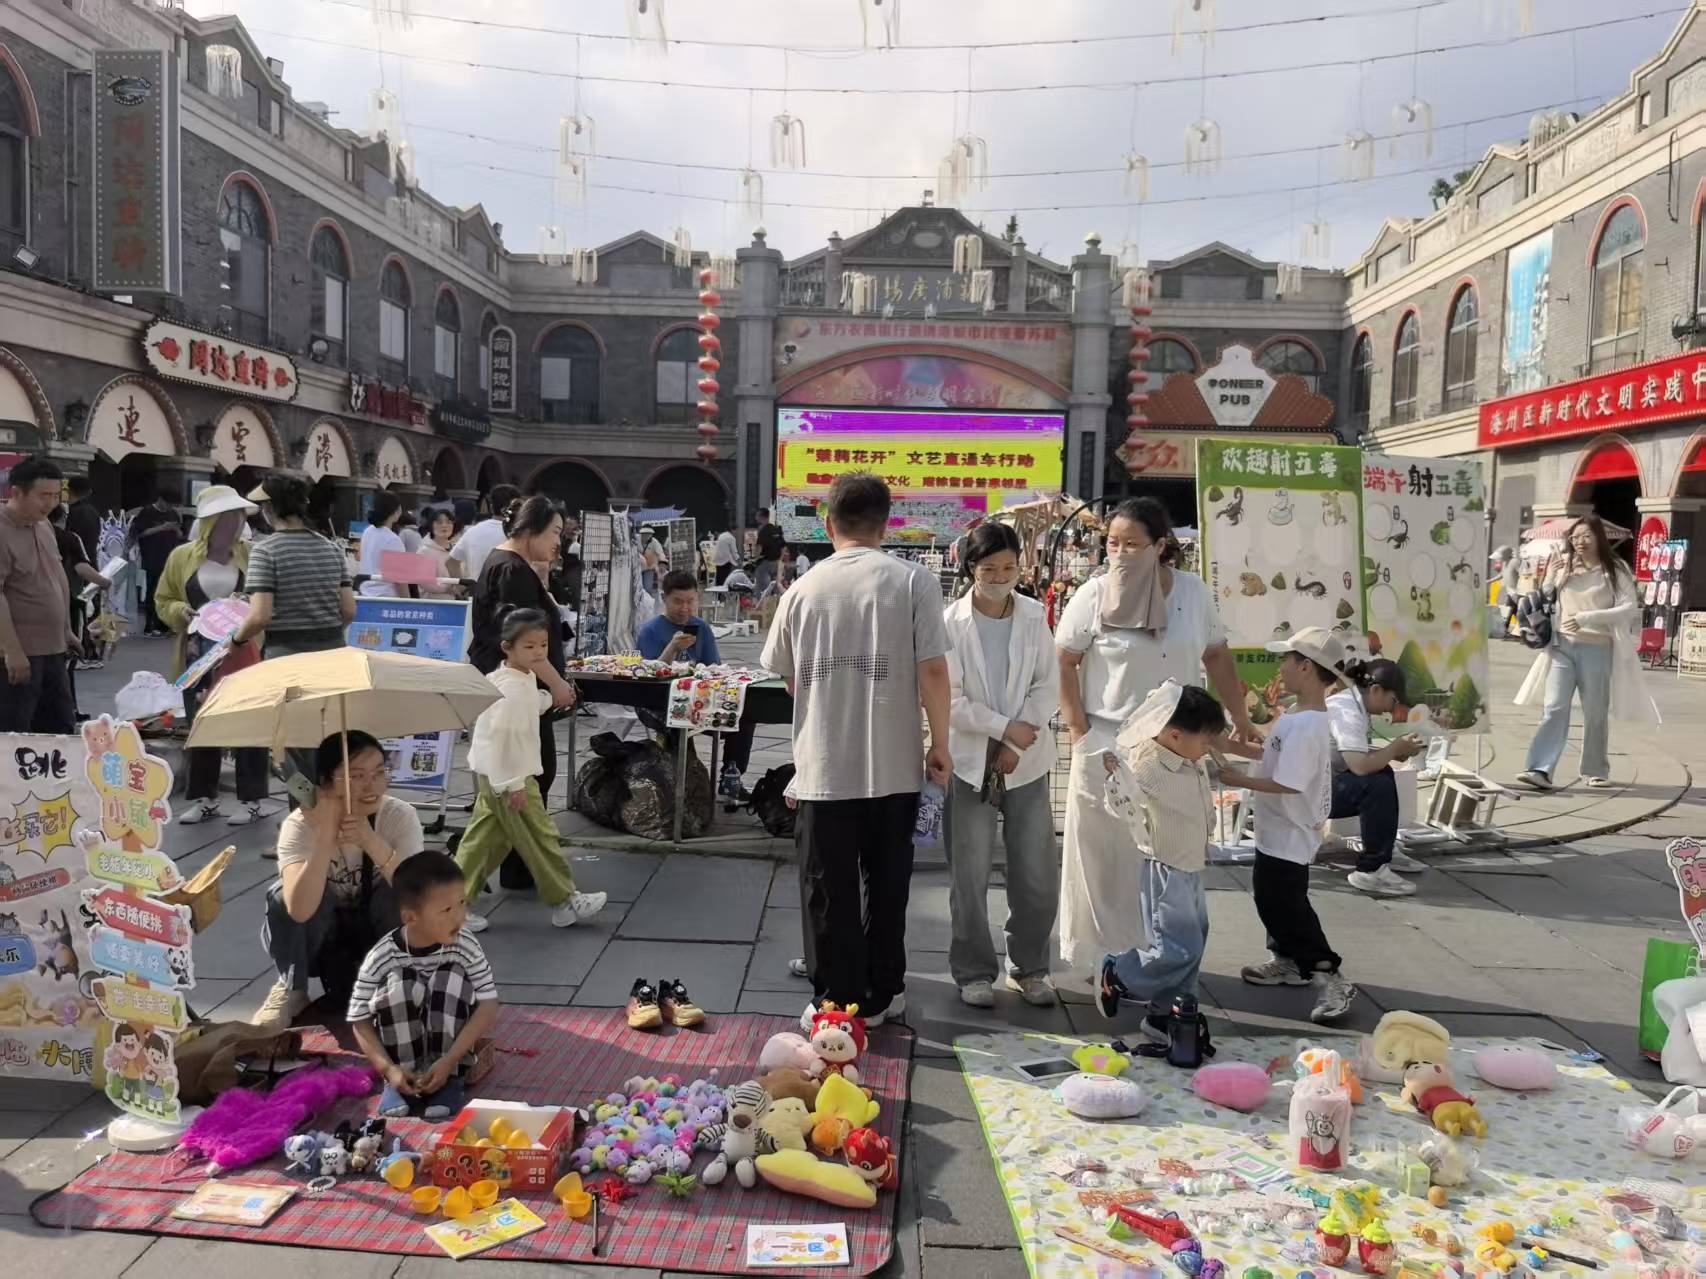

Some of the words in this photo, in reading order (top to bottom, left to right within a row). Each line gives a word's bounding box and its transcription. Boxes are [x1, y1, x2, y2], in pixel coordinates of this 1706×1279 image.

[1220, 394, 1250, 405] PUB
[907, 451, 1036, 468] 文艺直通车行动
[1363, 464, 1474, 497] 端午射五毒
[104, 898, 163, 934] 东西随便挑
